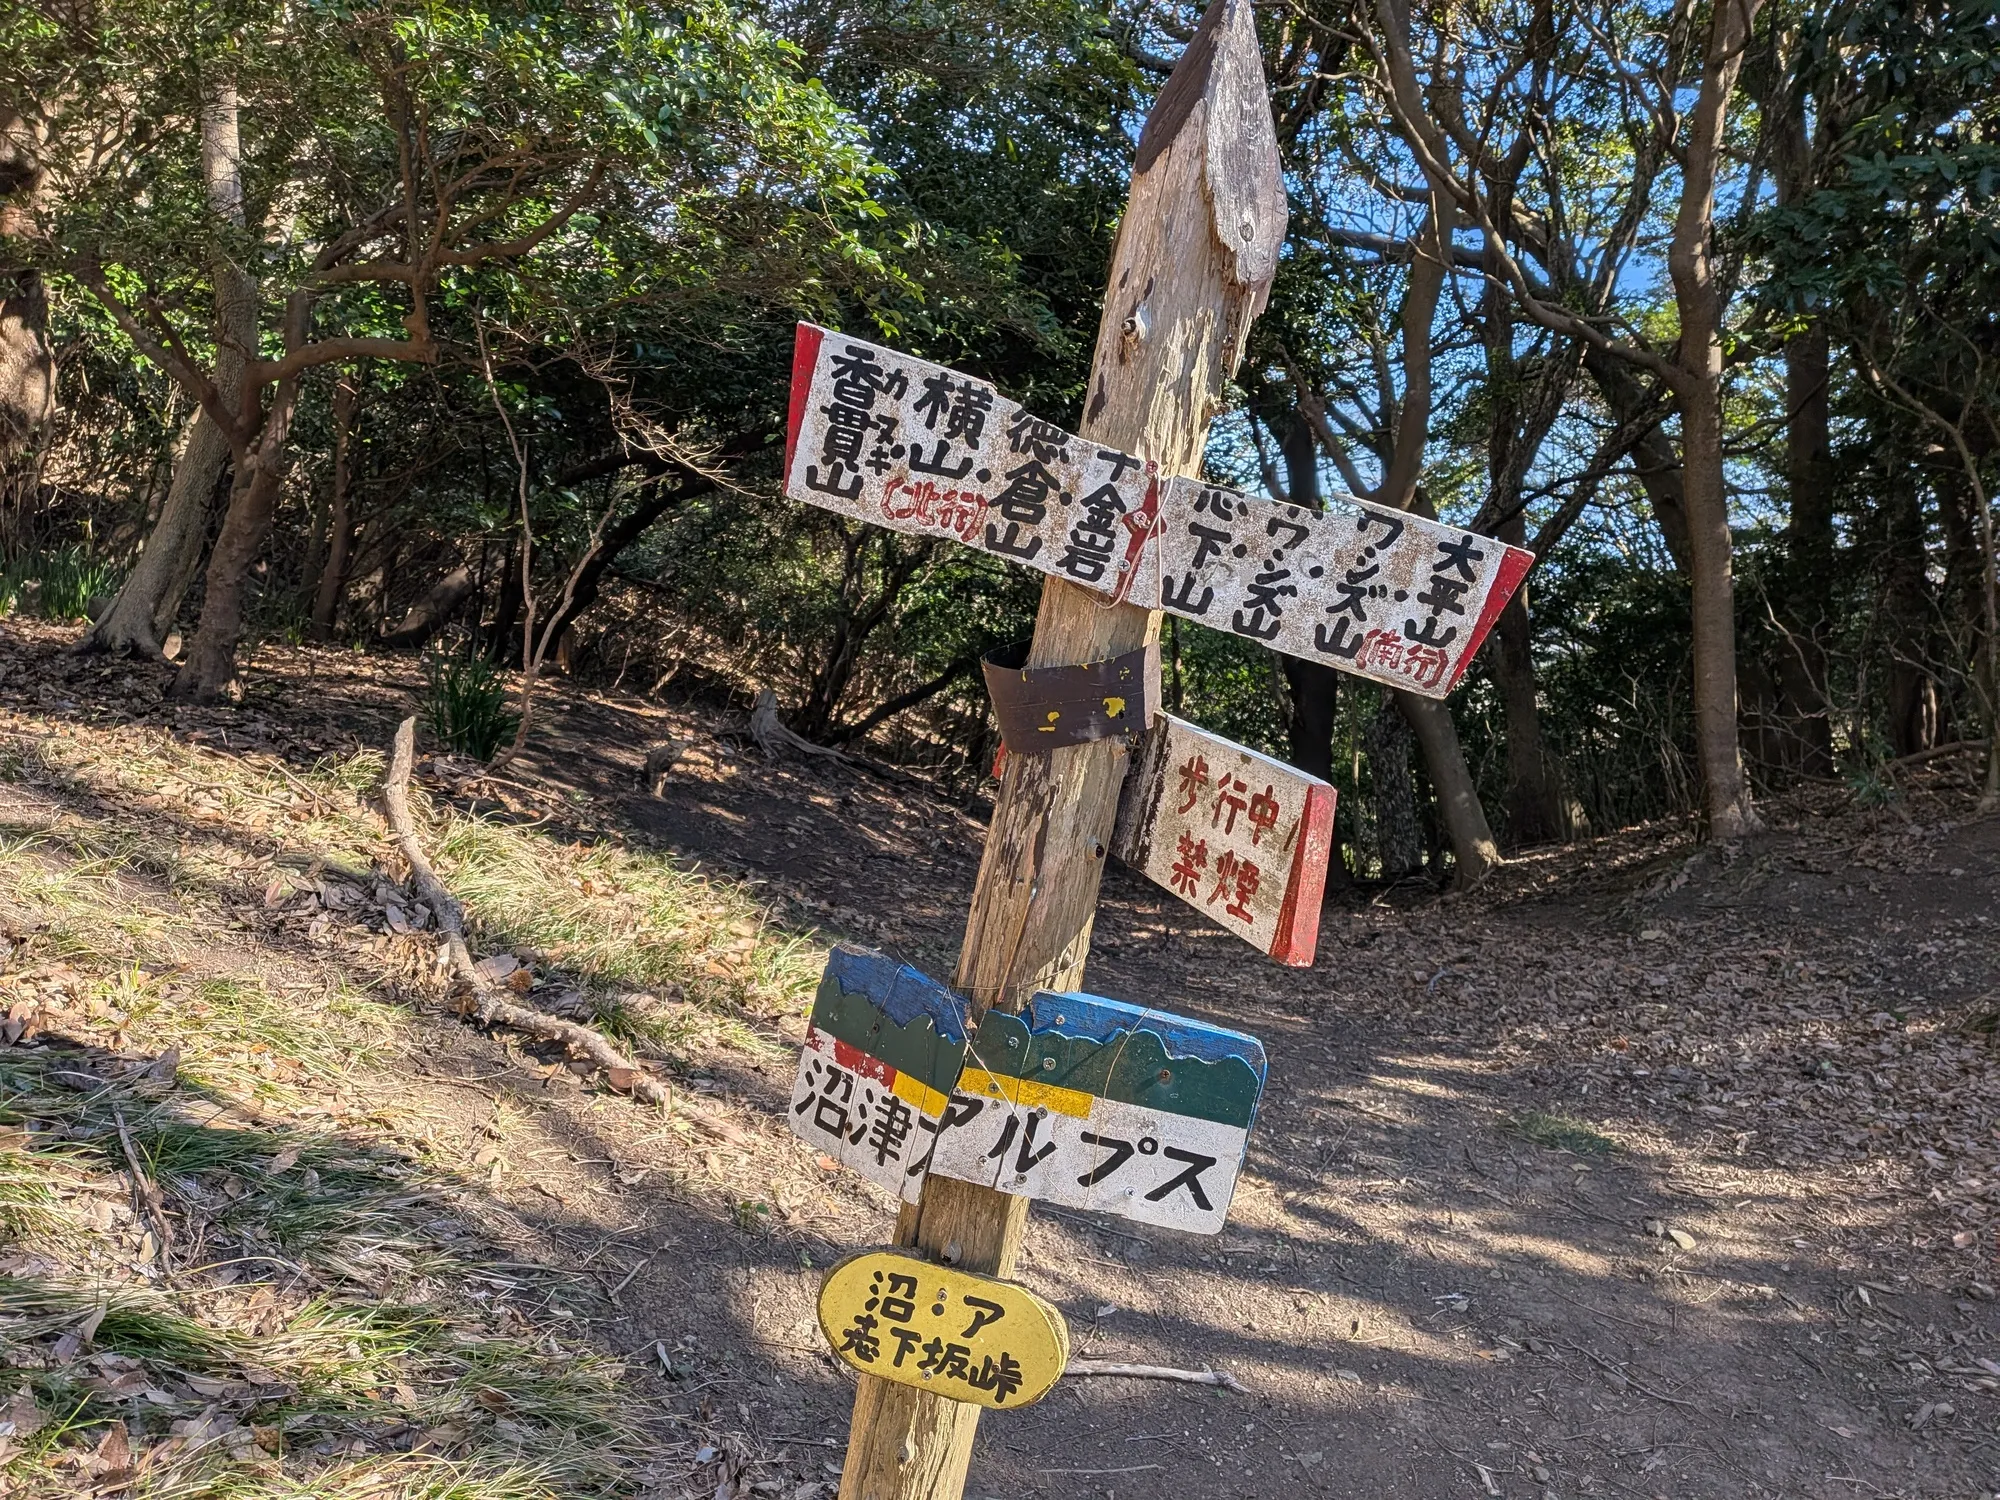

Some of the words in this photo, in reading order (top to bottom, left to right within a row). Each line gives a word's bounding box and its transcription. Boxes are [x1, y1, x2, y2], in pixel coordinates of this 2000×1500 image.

[806, 345, 883, 499] 香貫山
[909, 372, 993, 480] 横山
[1404, 534, 1484, 648] 大平山
[1178, 755, 1280, 845] 歩行中
[1170, 830, 1260, 925] 禁煙
[840, 1314, 1023, 1403] 志下坂峠
